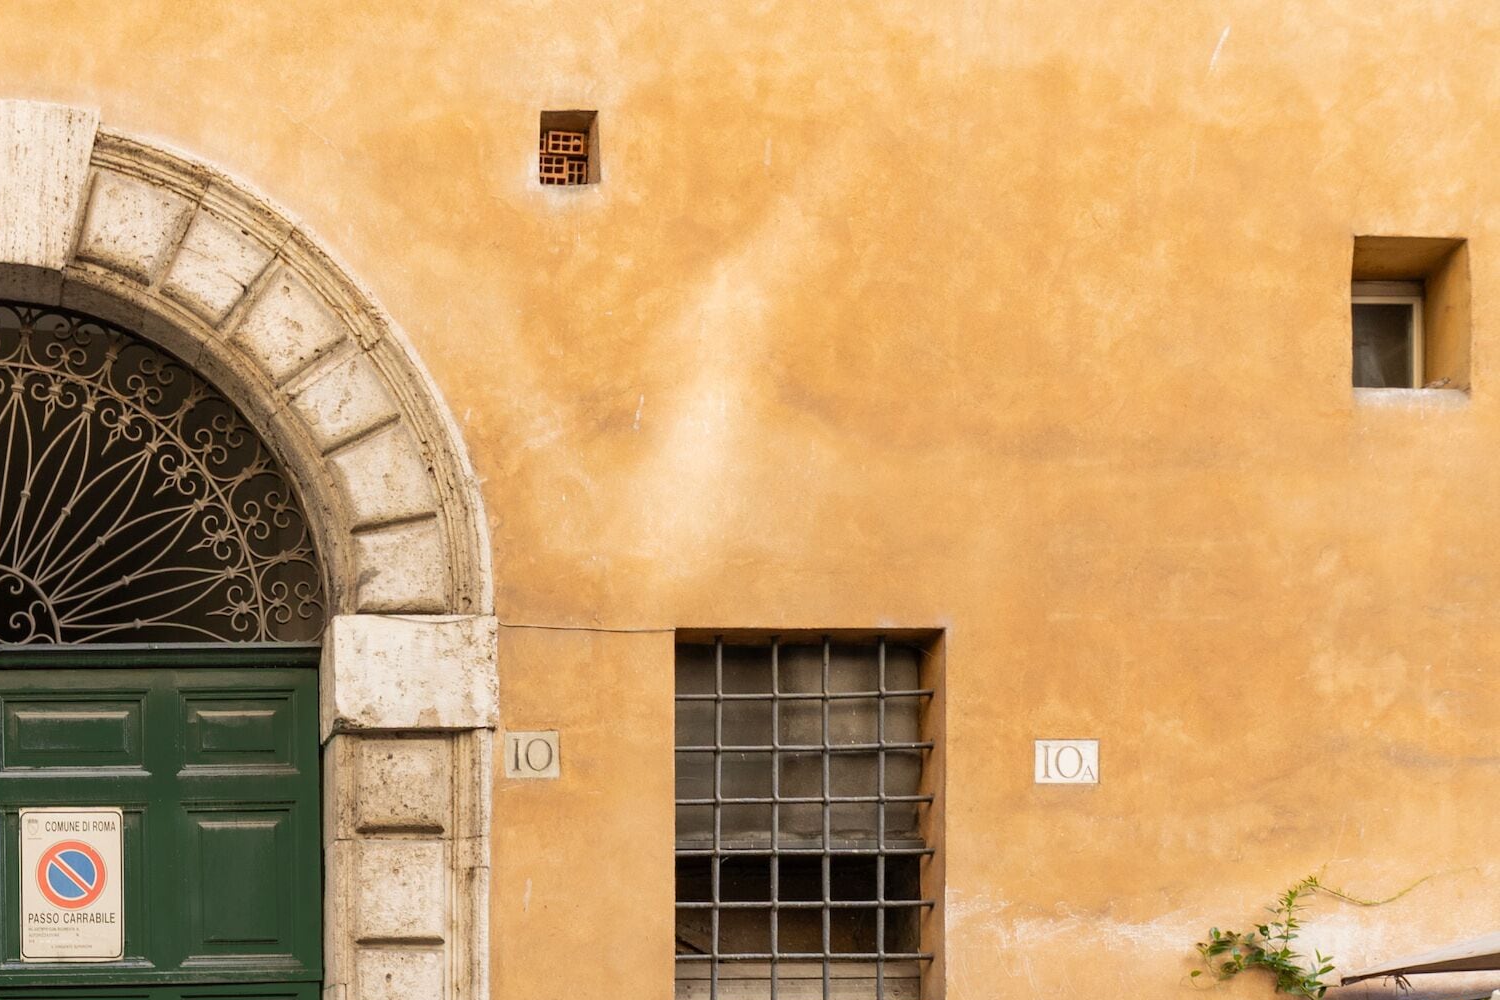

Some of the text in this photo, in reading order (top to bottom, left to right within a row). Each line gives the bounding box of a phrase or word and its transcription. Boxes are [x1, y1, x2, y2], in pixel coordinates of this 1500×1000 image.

[512, 738, 553, 772] 10
[45, 821, 116, 832] COMUNE DI ROMA
[28, 913, 116, 924] PASSO CARRABILE
